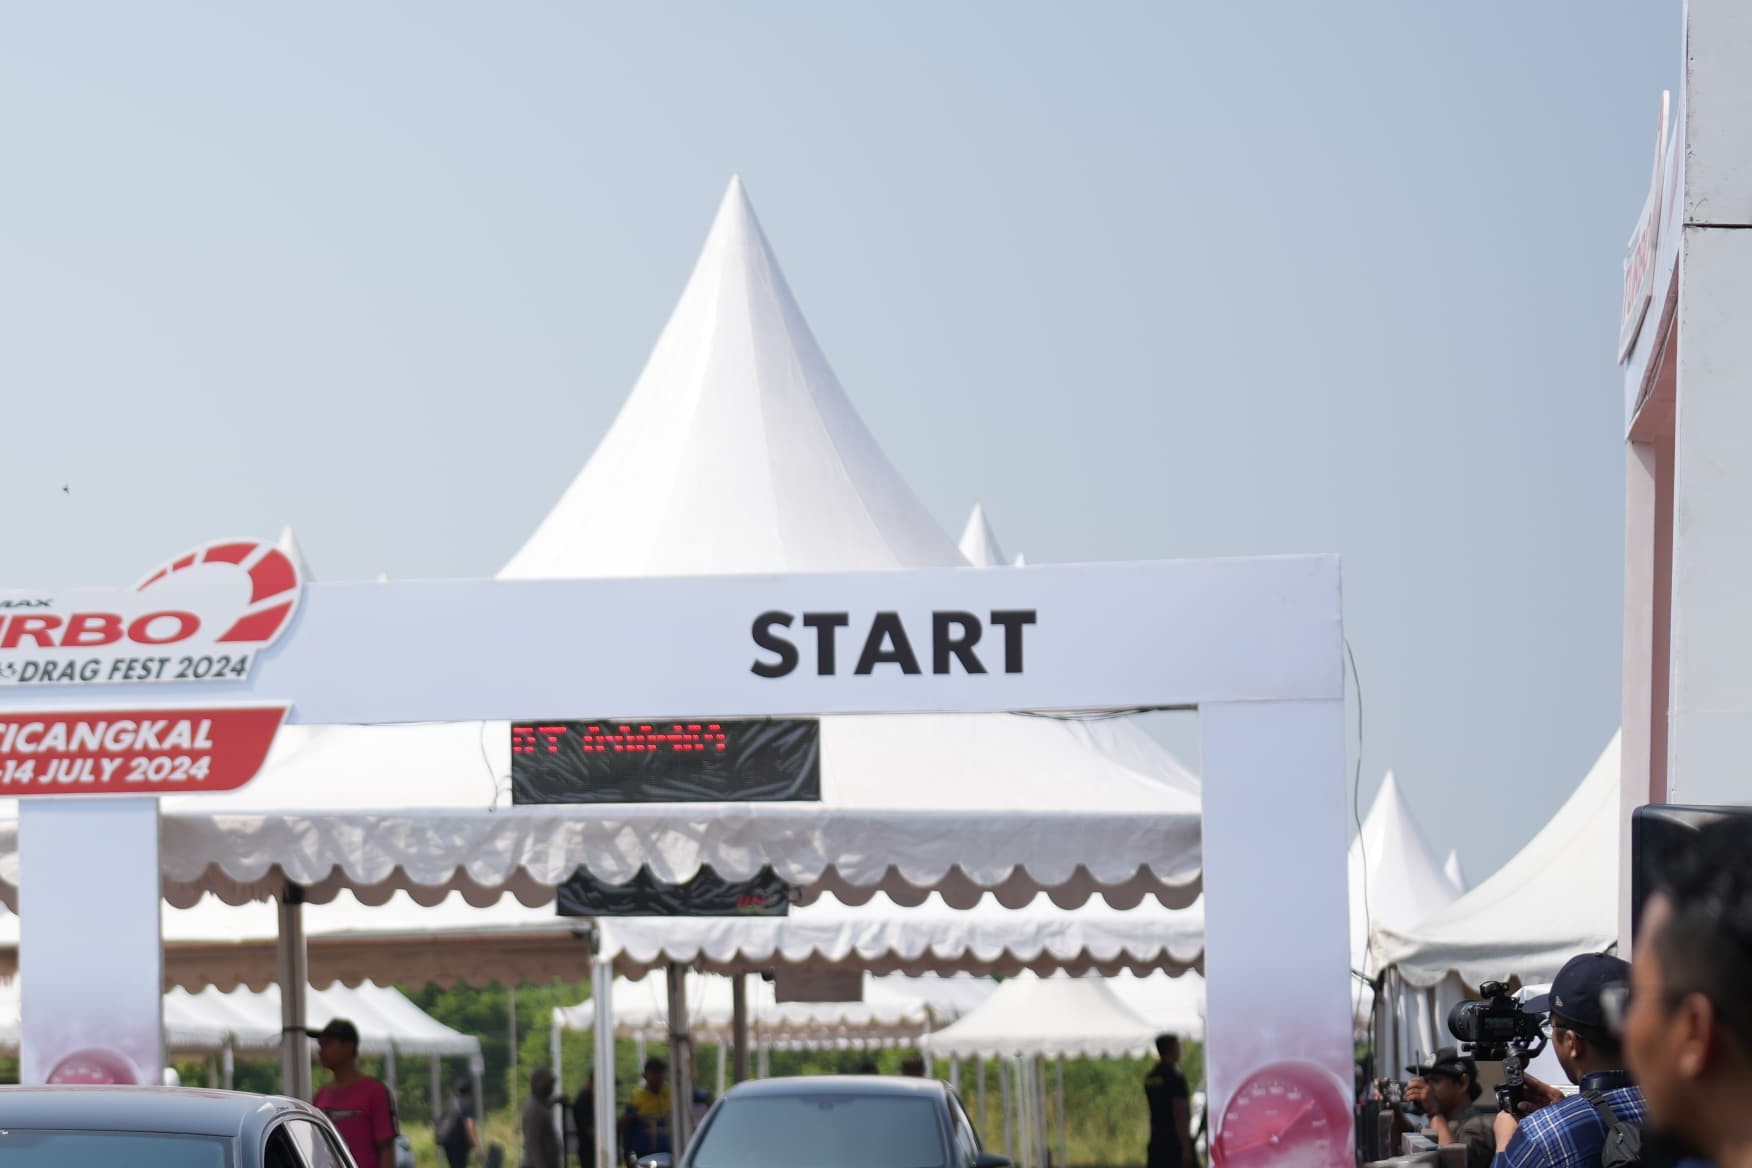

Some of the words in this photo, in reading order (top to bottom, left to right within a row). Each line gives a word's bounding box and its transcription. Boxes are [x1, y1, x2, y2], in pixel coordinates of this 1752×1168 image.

[750, 609, 1037, 679] START
[18, 657, 102, 683] DRAG
[107, 656, 170, 681] FEST
[173, 654, 248, 680] 2024
[37, 757, 124, 784] JULY
[124, 755, 212, 782] 2024
